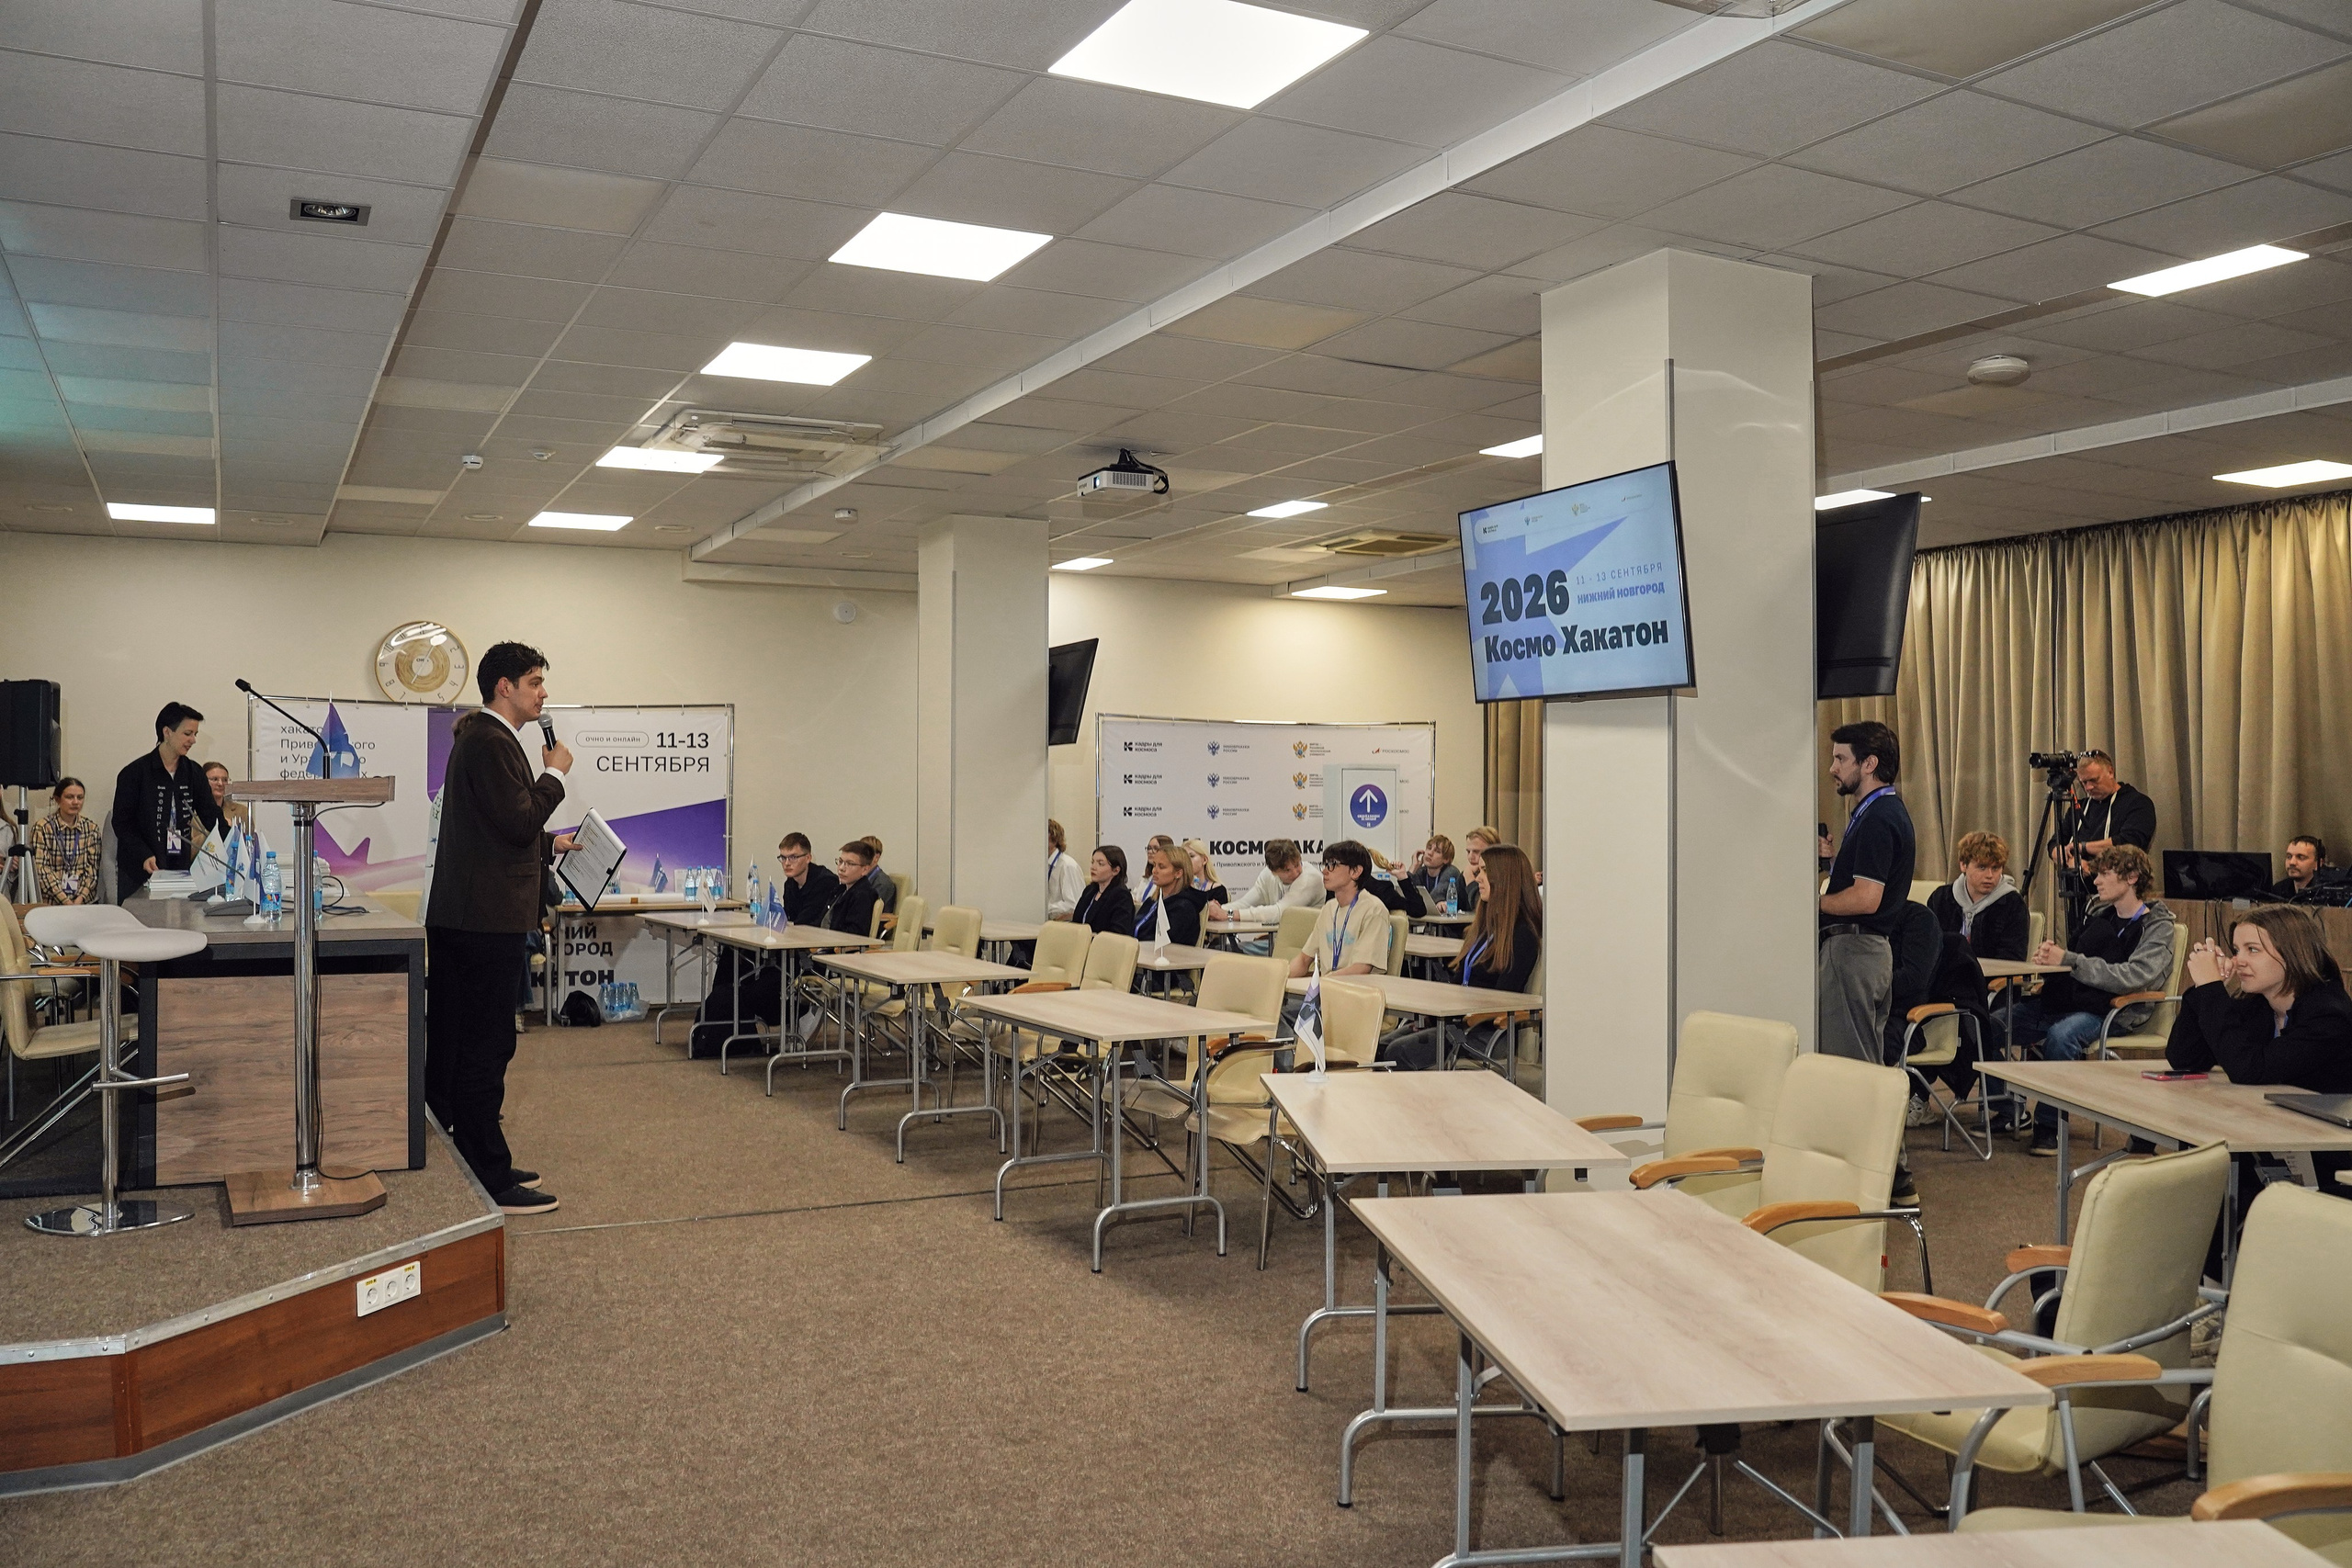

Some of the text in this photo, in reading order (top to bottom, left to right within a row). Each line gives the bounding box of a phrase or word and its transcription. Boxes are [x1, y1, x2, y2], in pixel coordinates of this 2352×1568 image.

[1576, 575, 1586, 585] 11
[1596, 571, 1607, 581] 13
[1611, 562, 1663, 579] СЕНТЯБРЯ
[1480, 569, 1570, 626] 2026
[1577, 581, 1665, 604] НИЖНИЙ НОВГОРОД
[1485, 620, 1668, 663] Космо Хакатон
[656, 732, 709, 749] 11-13
[596, 756, 709, 773] СЕНТЯБРЯ
